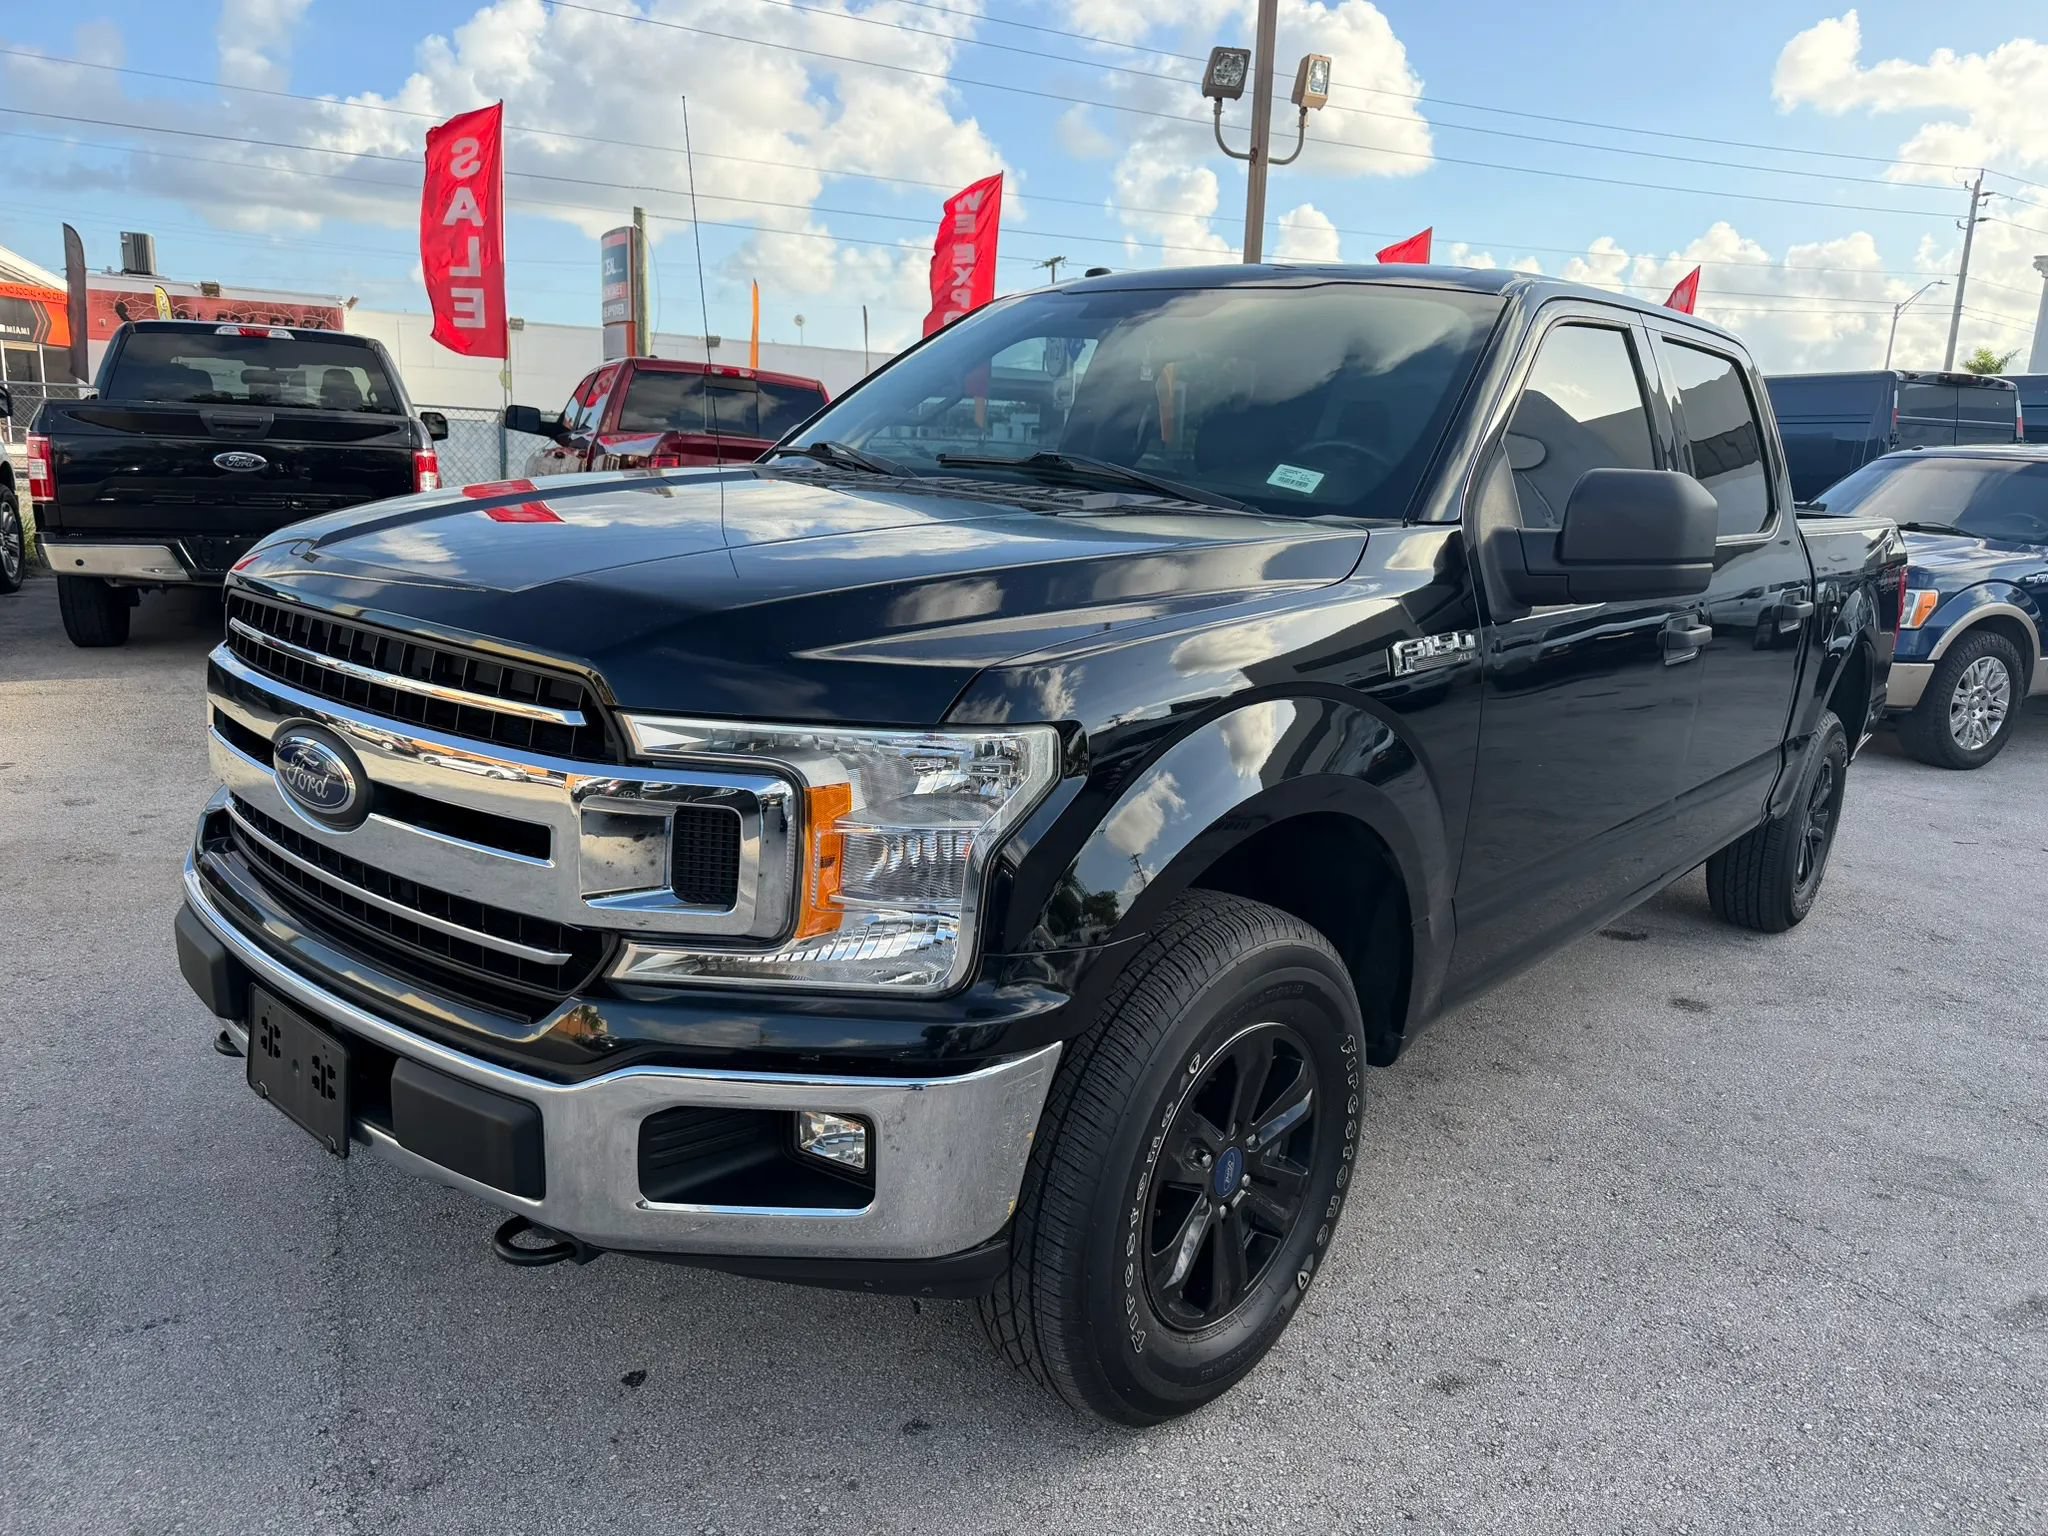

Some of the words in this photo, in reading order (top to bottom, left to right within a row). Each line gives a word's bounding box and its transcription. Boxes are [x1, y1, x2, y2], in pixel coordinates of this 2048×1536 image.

[6, 325, 30, 336] MIAMI
[226, 455, 255, 468] Ford
[286, 748, 330, 799] Ford
